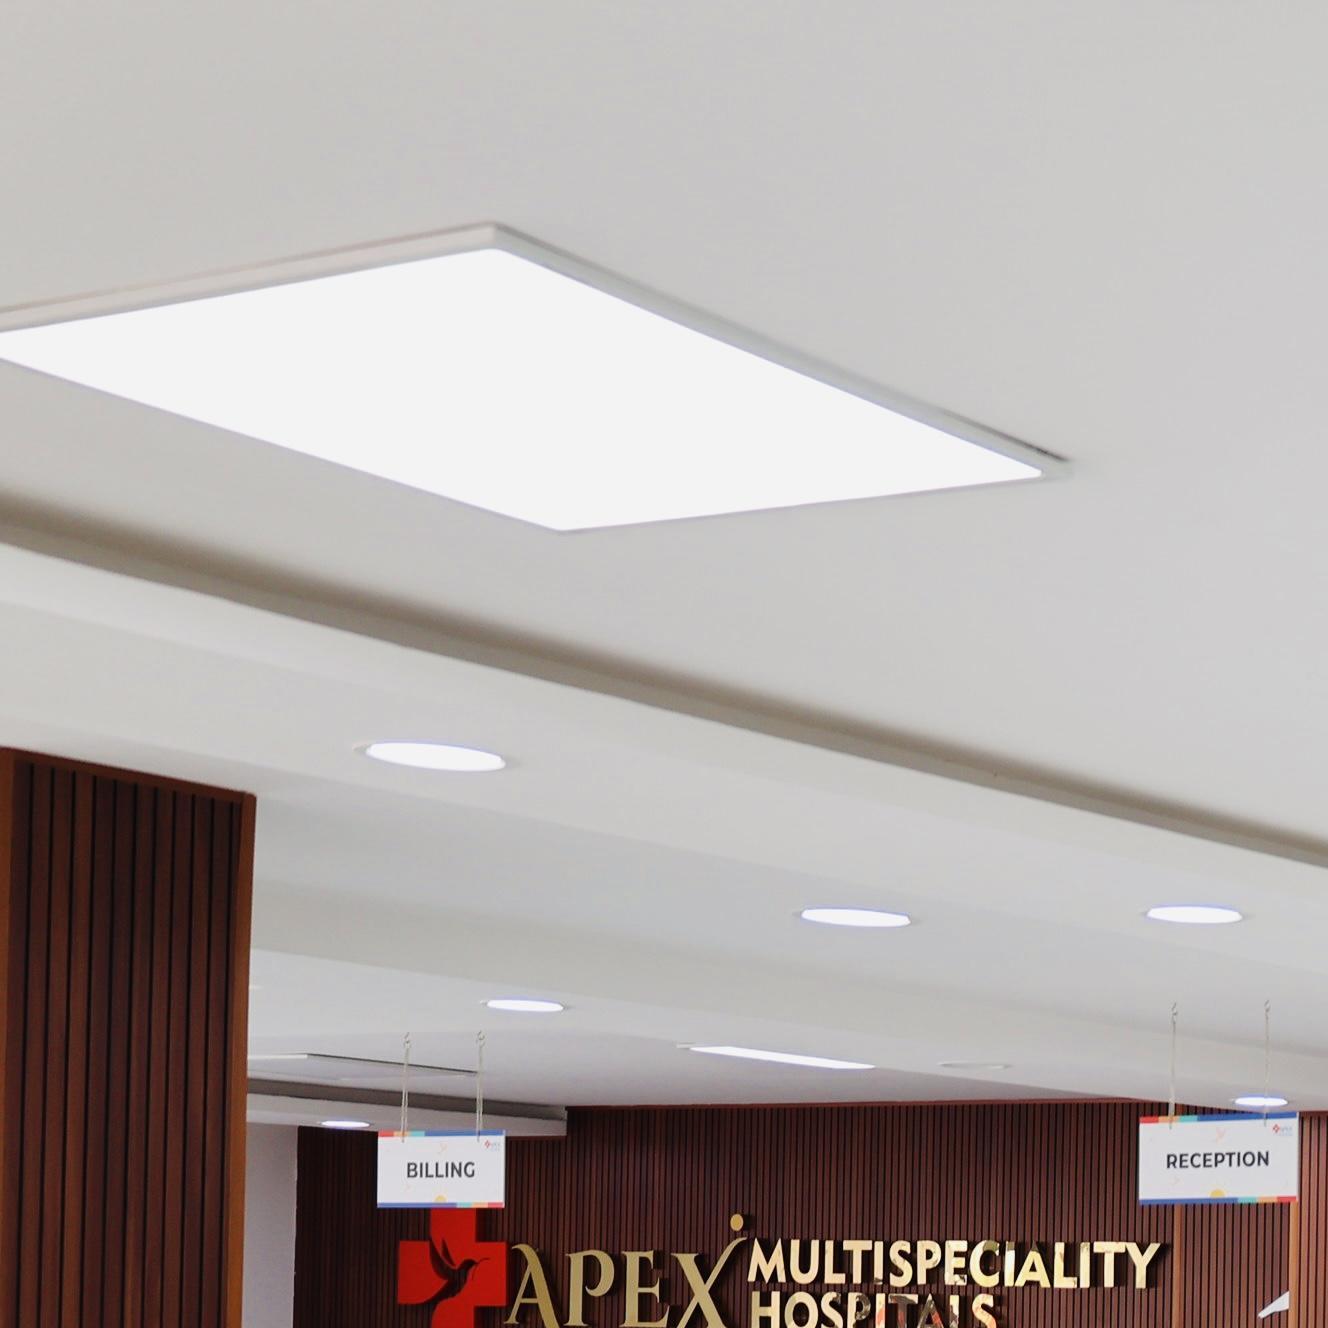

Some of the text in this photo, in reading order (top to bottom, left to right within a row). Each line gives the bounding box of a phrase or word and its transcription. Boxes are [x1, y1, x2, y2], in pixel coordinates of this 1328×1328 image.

[1166, 1151, 1270, 1169] RECEPTION
[406, 1161, 475, 1178] BILLING
[747, 1237, 1161, 1289] MULTISPECIALITY
